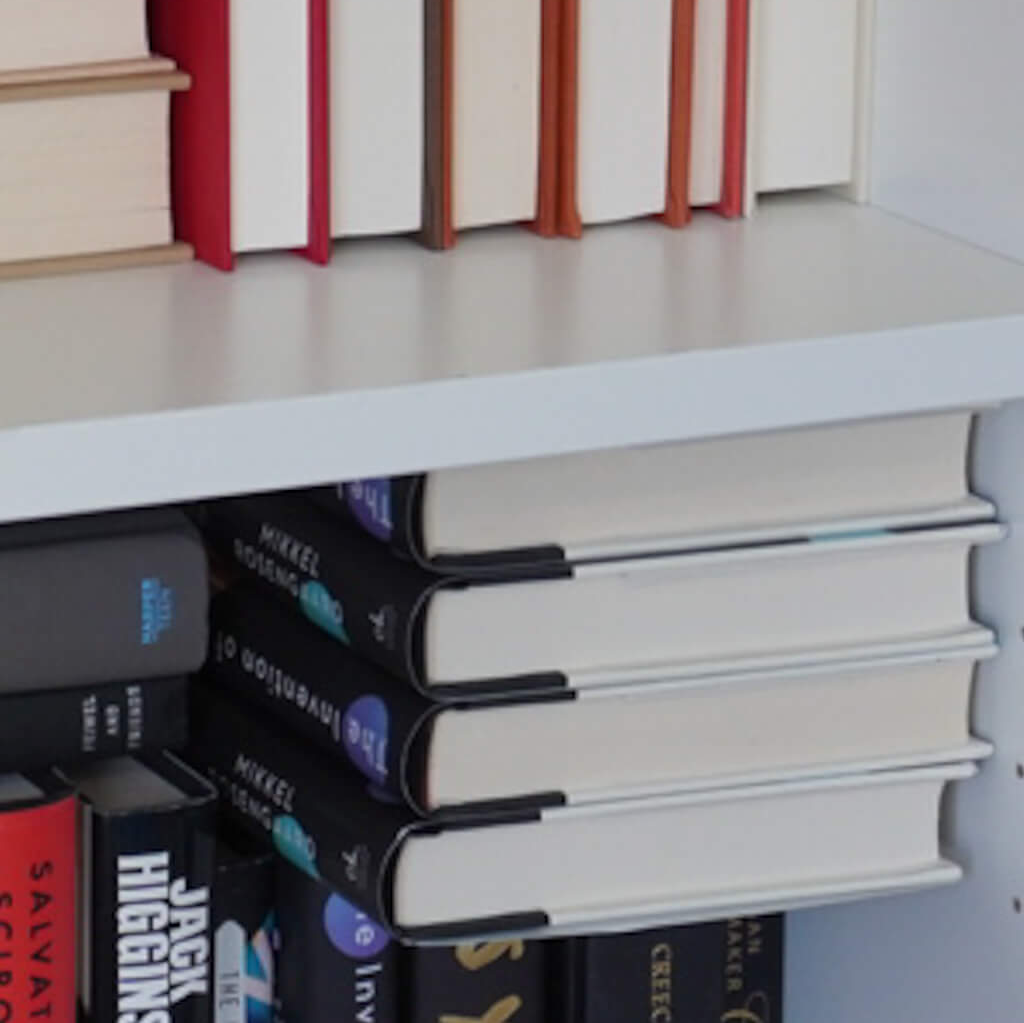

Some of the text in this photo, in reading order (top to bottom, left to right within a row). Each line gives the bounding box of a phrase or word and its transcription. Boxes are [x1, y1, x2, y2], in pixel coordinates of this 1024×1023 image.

[259, 523, 319, 579] MIKKEL
[241, 649, 341, 743] Invention
[234, 754, 295, 813] MIKKEL
[30, 860, 54, 1019] SALVAT
[170, 878, 210, 1002] JACK
